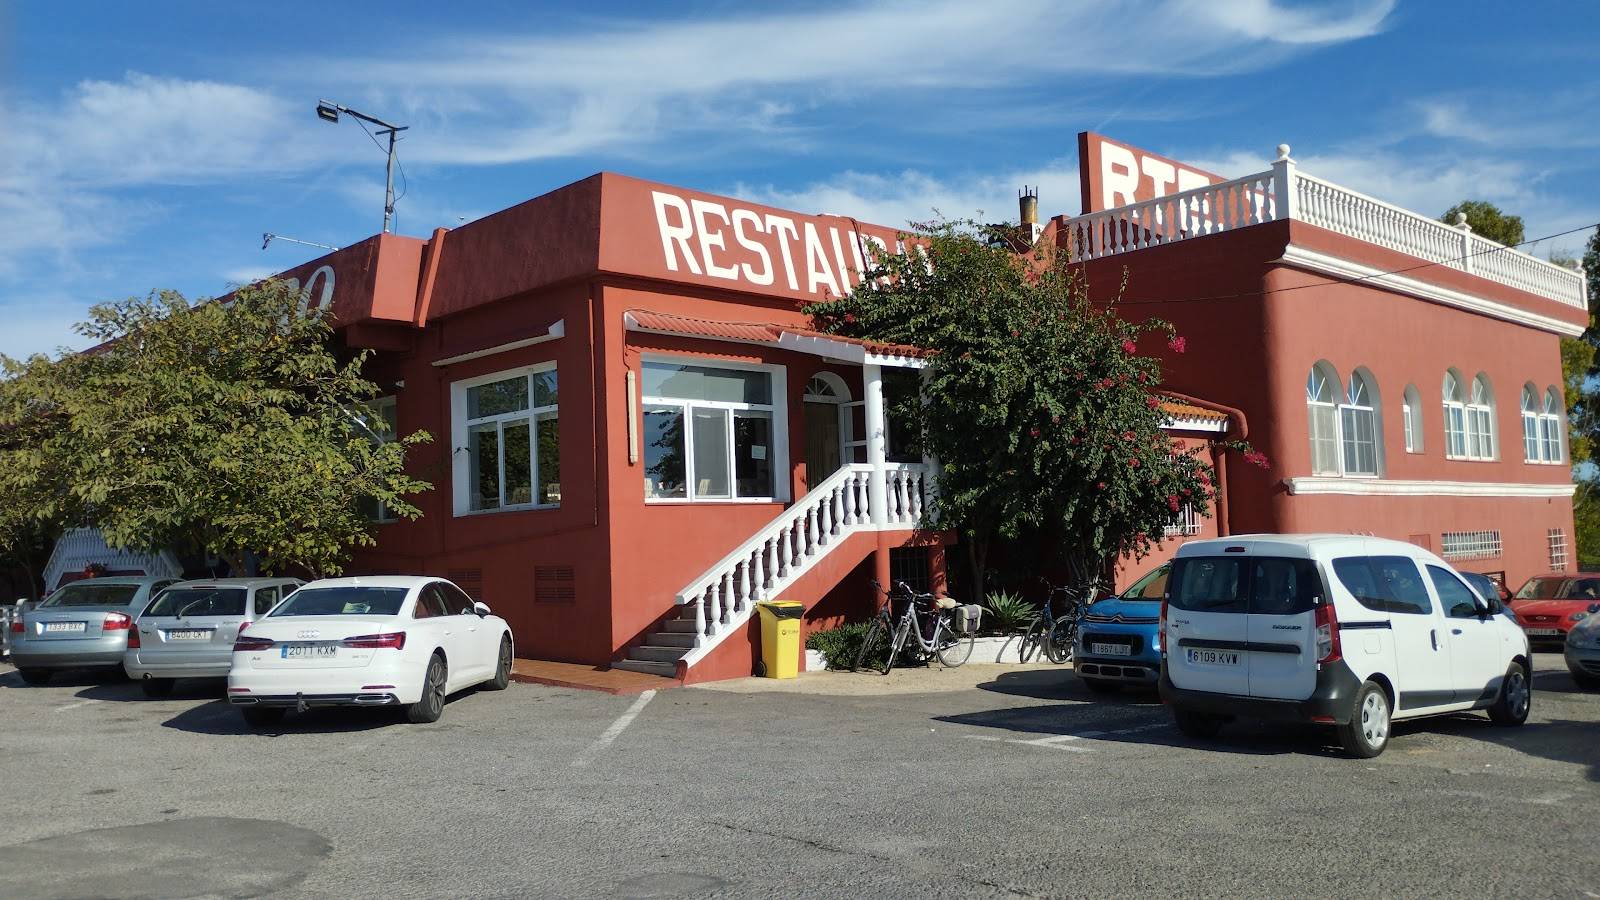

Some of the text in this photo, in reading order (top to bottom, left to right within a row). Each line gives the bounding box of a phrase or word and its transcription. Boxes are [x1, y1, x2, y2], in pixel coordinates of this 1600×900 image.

[317, 645, 336, 656] KXM
[1193, 651, 1238, 664] 6109 KVW
